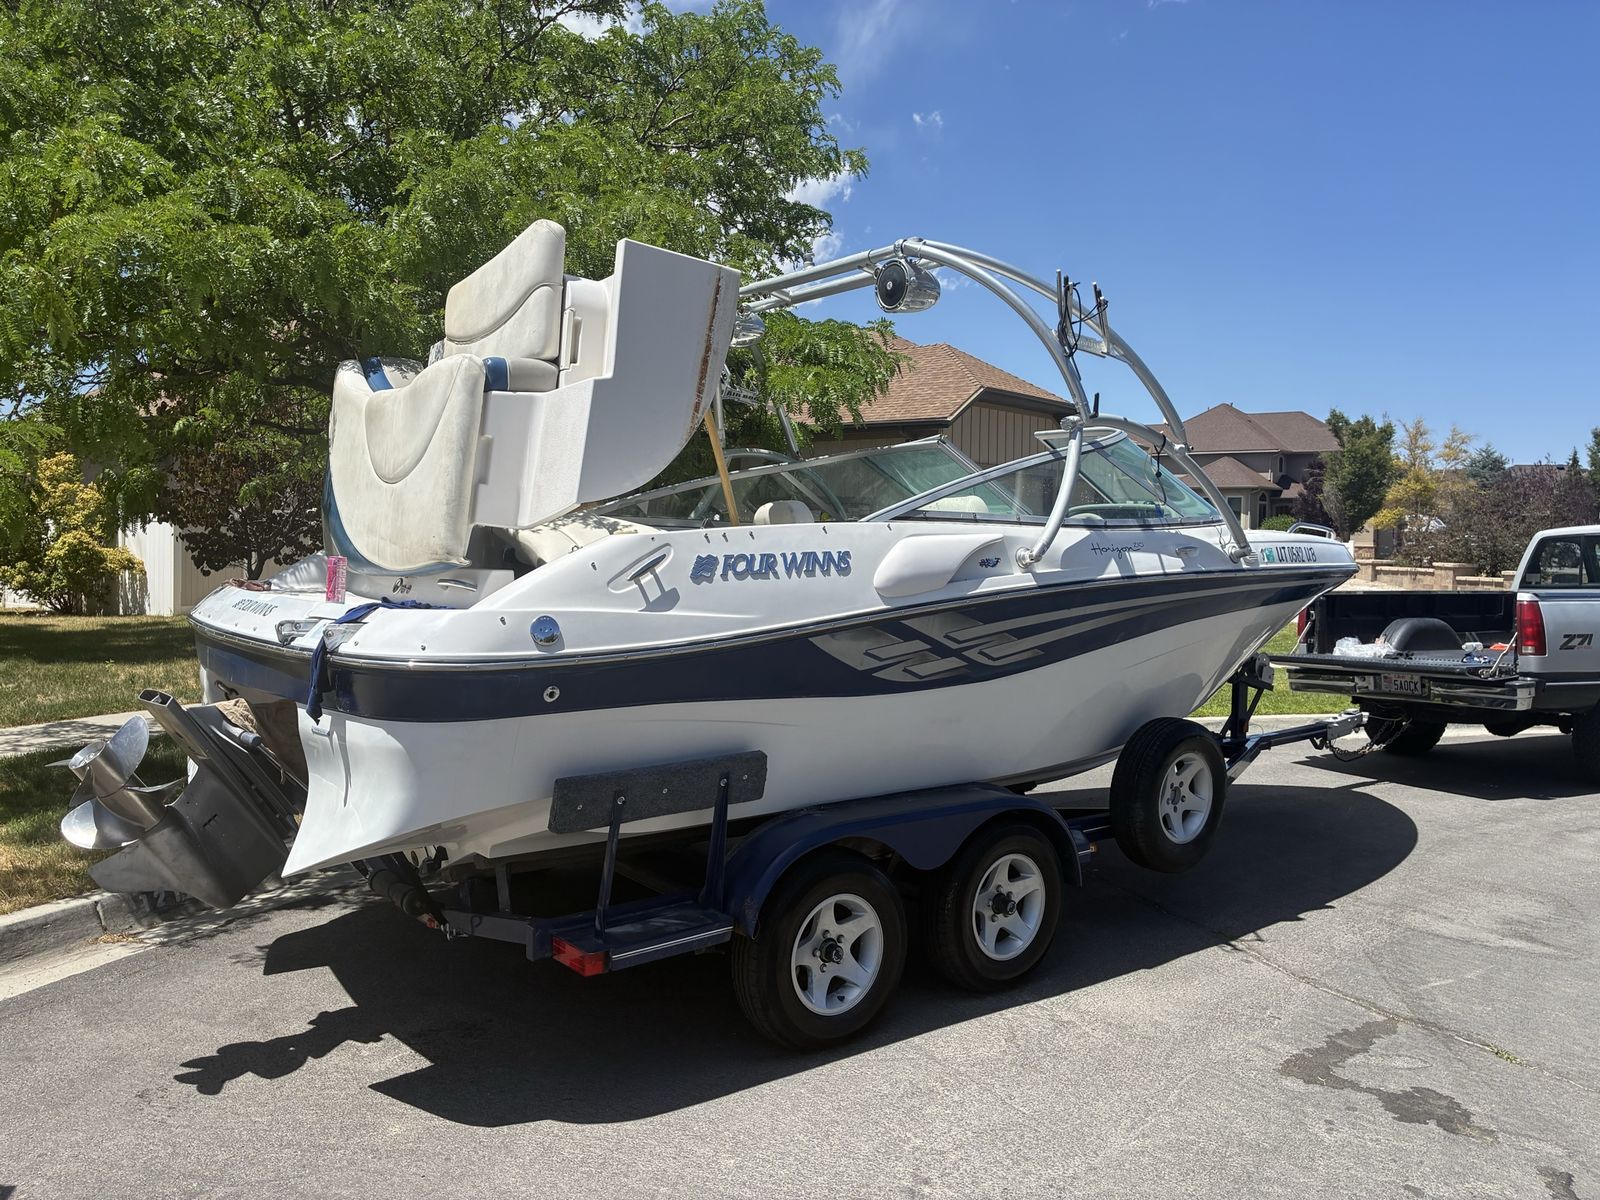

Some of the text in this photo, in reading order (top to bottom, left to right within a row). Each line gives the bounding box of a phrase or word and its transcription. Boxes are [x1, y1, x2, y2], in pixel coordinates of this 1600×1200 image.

[1091, 542, 1140, 559] Horizon
[722, 550, 851, 577] FOUR WINNS
[1559, 633, 1593, 650] Z71
